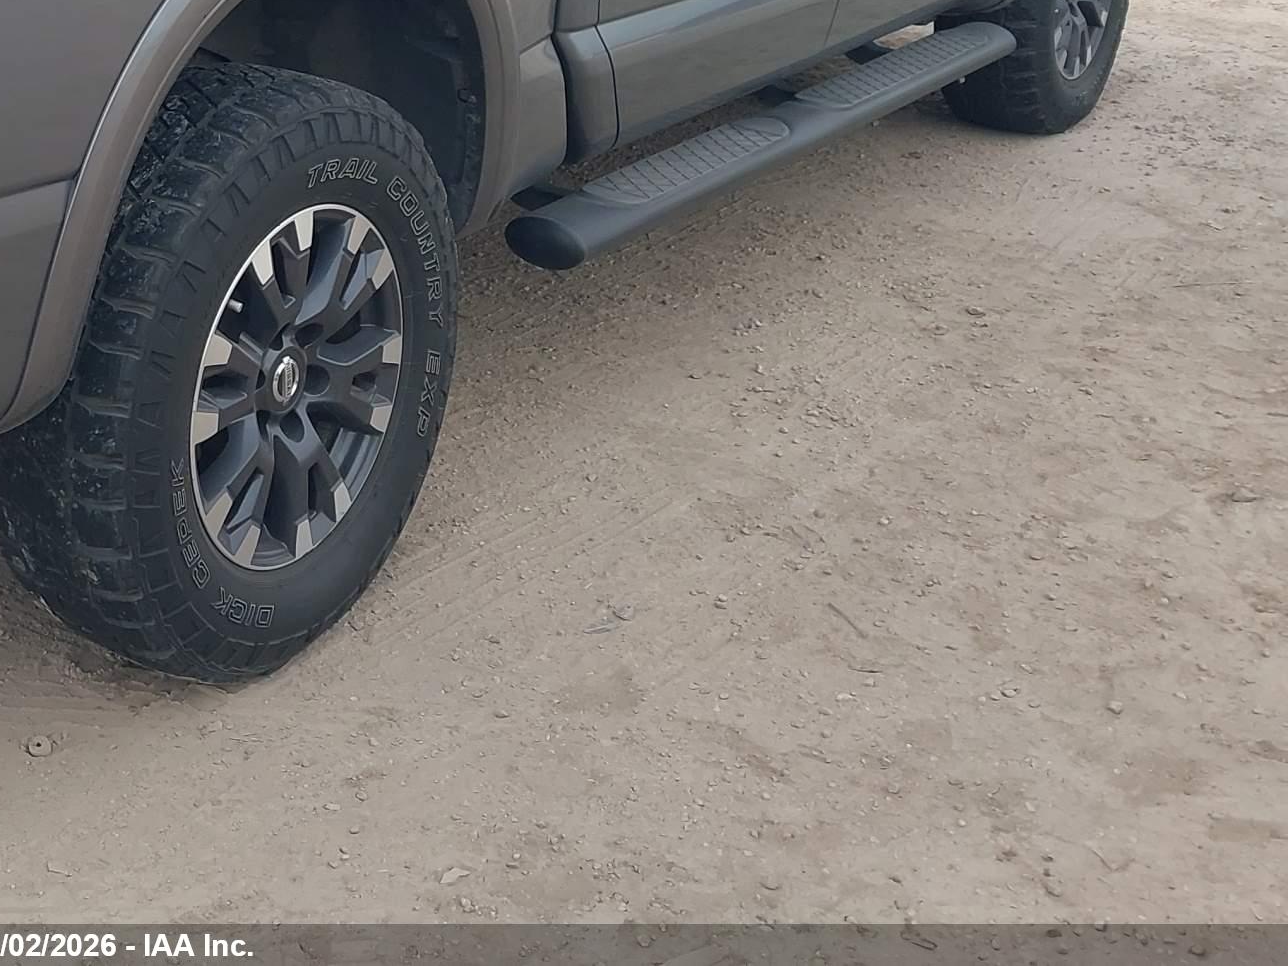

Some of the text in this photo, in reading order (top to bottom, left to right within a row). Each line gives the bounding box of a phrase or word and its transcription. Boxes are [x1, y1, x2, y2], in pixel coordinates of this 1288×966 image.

[307, 157, 445, 438] TRAIL COUNTRY EXP
[170, 457, 275, 628] DICK CEPEK
